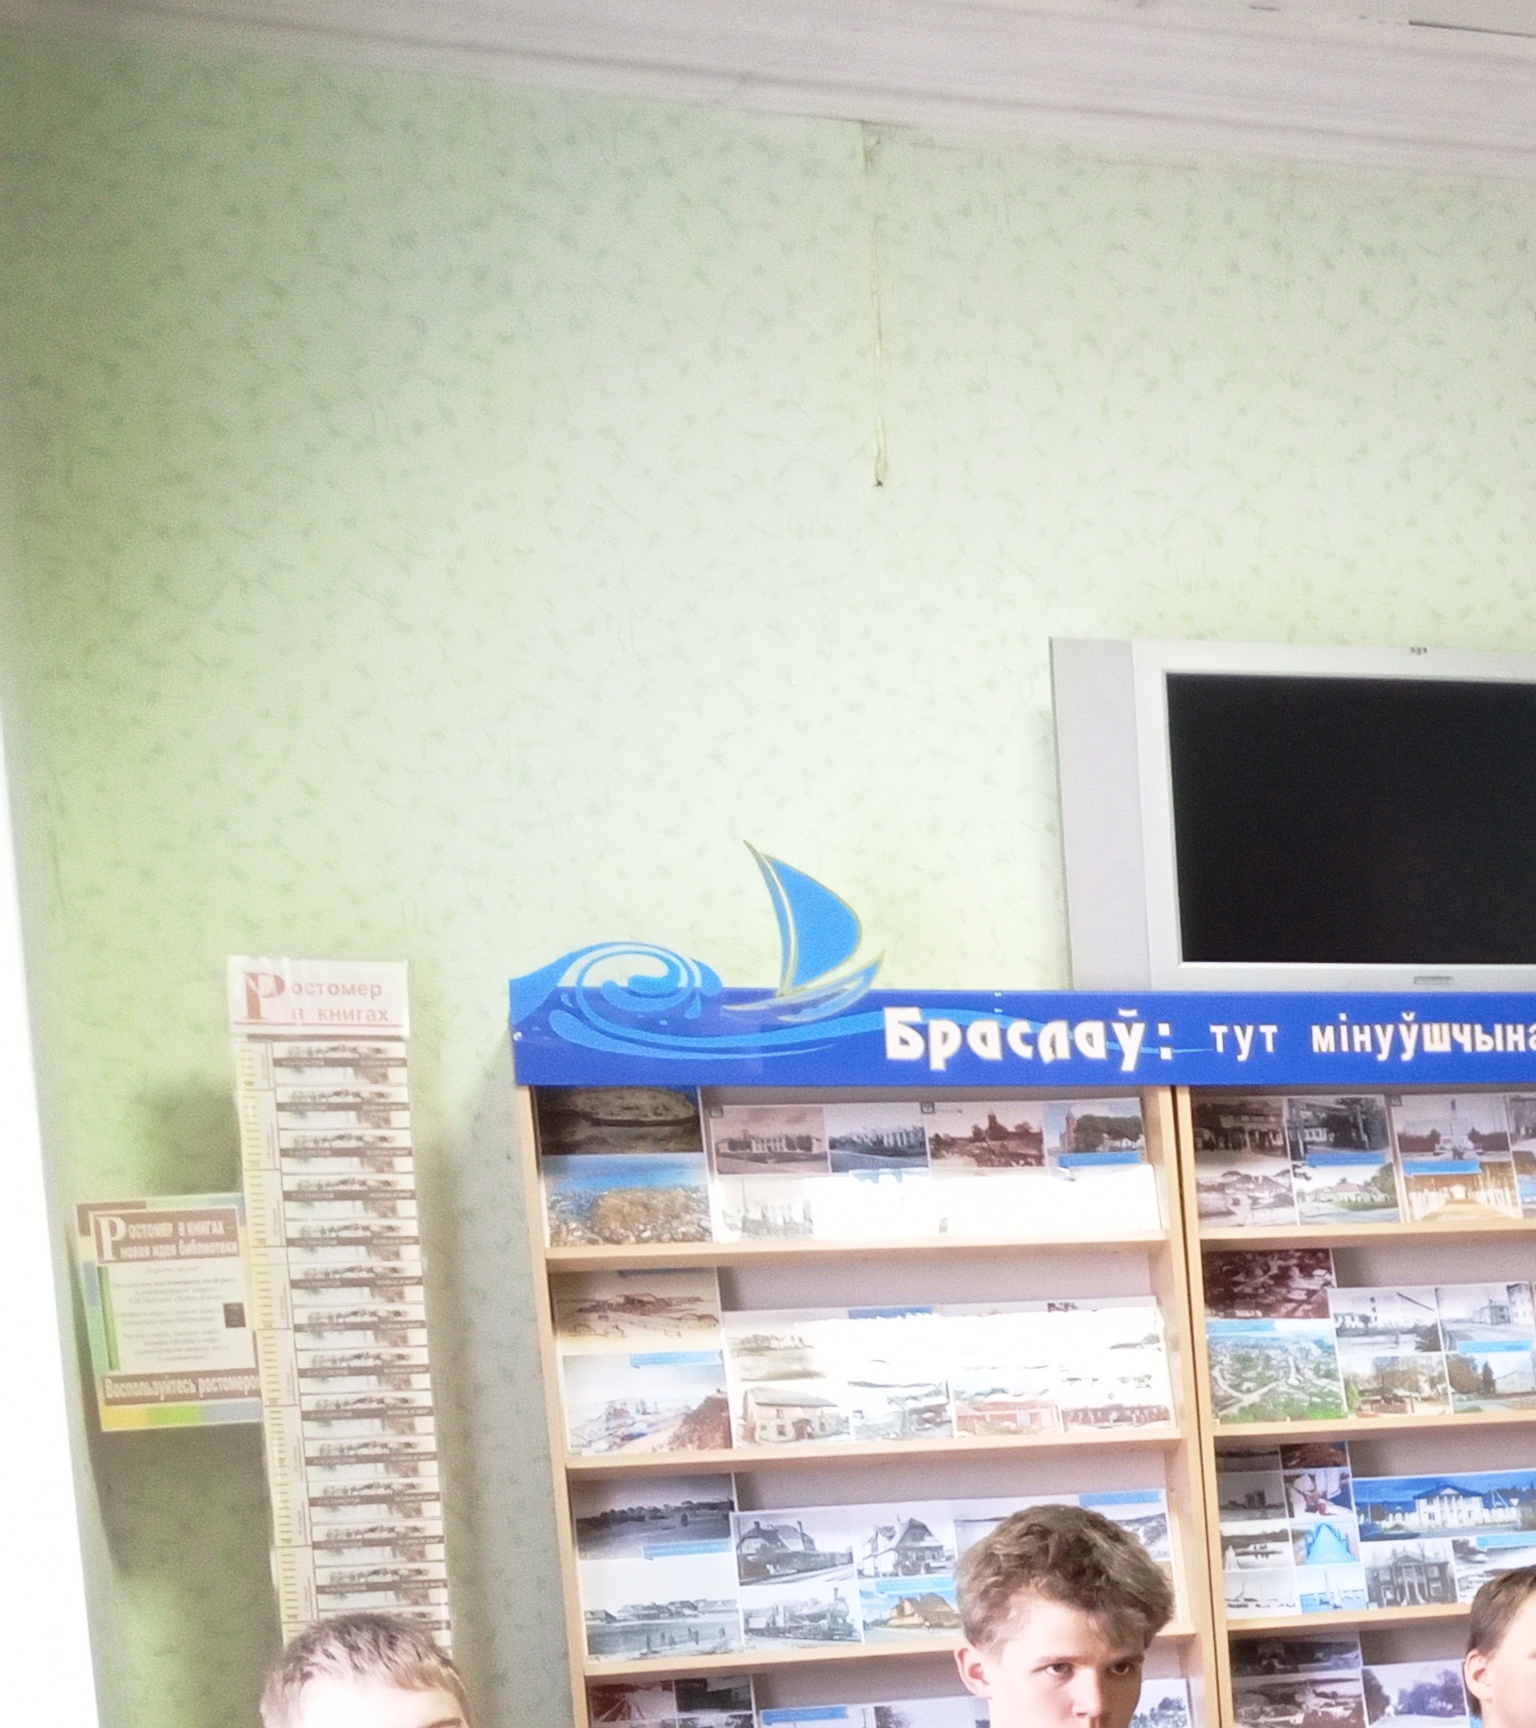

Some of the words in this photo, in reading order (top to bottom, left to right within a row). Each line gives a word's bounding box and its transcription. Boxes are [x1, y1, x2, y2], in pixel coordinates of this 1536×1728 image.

[242, 971, 382, 1021] Ростомер
[318, 1008, 389, 1023] книгах
[883, 1006, 1173, 1071] Браслаў:
[1209, 1023, 1278, 1062] тут
